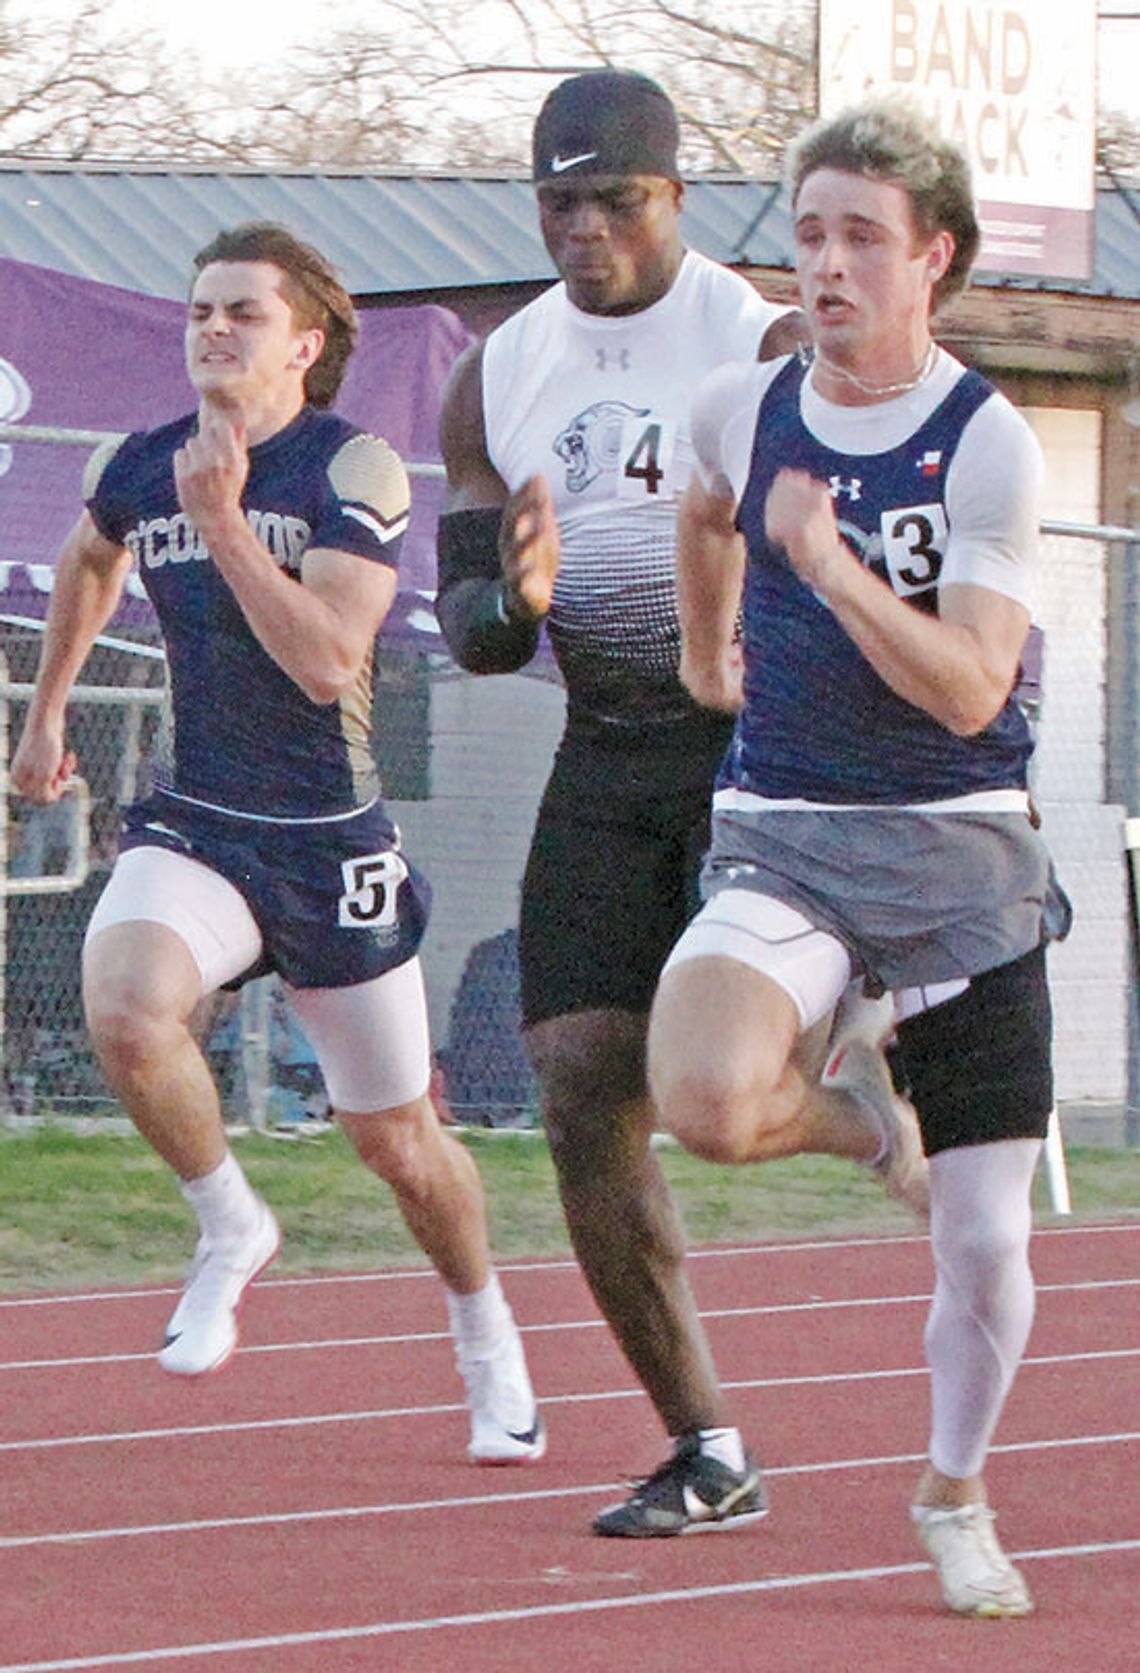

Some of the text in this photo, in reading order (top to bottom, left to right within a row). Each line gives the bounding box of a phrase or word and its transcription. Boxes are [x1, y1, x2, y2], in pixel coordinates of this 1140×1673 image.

[889, 0, 1031, 95] BAND
[934, 99, 1029, 177] ACK
[624, 423, 664, 494] 4
[892, 513, 944, 586] 3
[347, 862, 386, 920] 5
